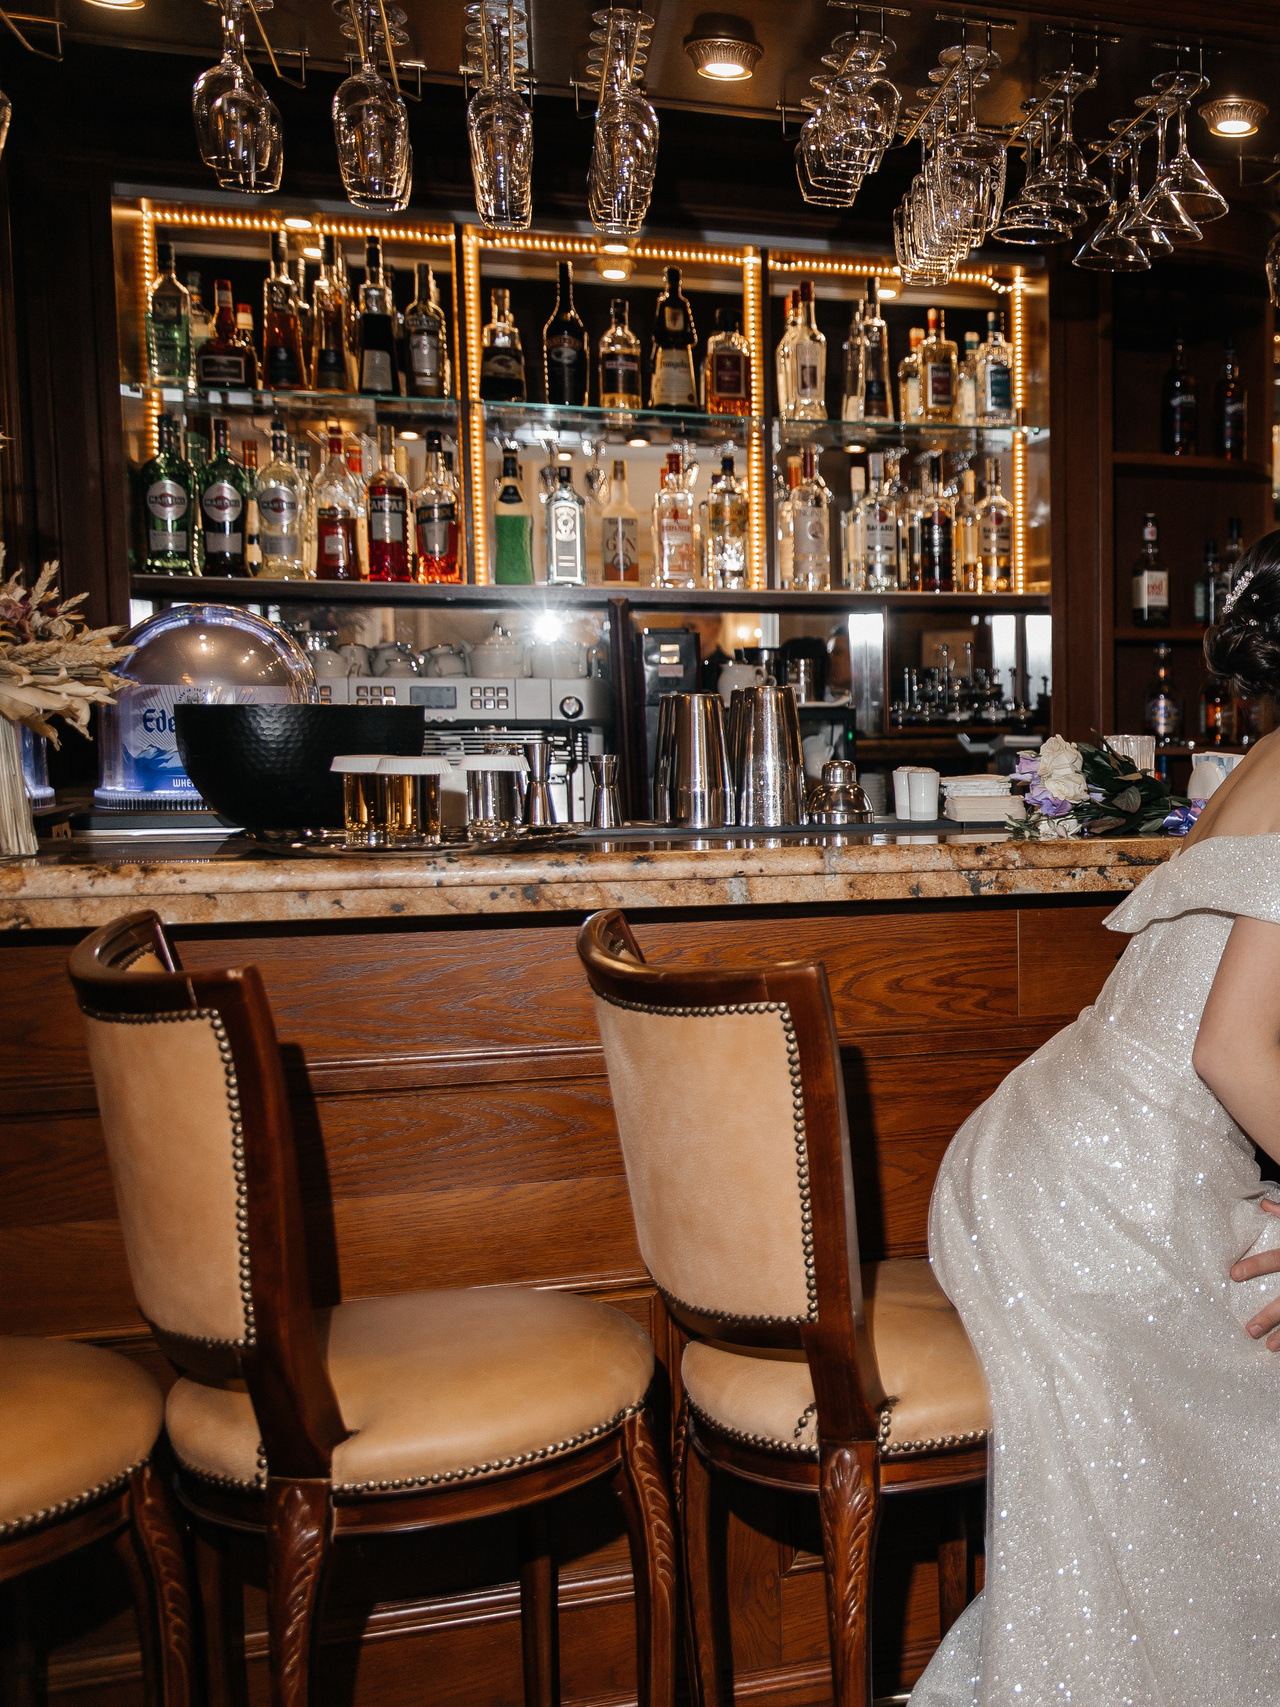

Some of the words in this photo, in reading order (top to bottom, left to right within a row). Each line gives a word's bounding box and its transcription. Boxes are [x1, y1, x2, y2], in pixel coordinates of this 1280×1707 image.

[149, 496, 185, 505] MARTINI
[204, 498, 240, 507] MARTINI
[261, 501, 296, 509] MARTINI
